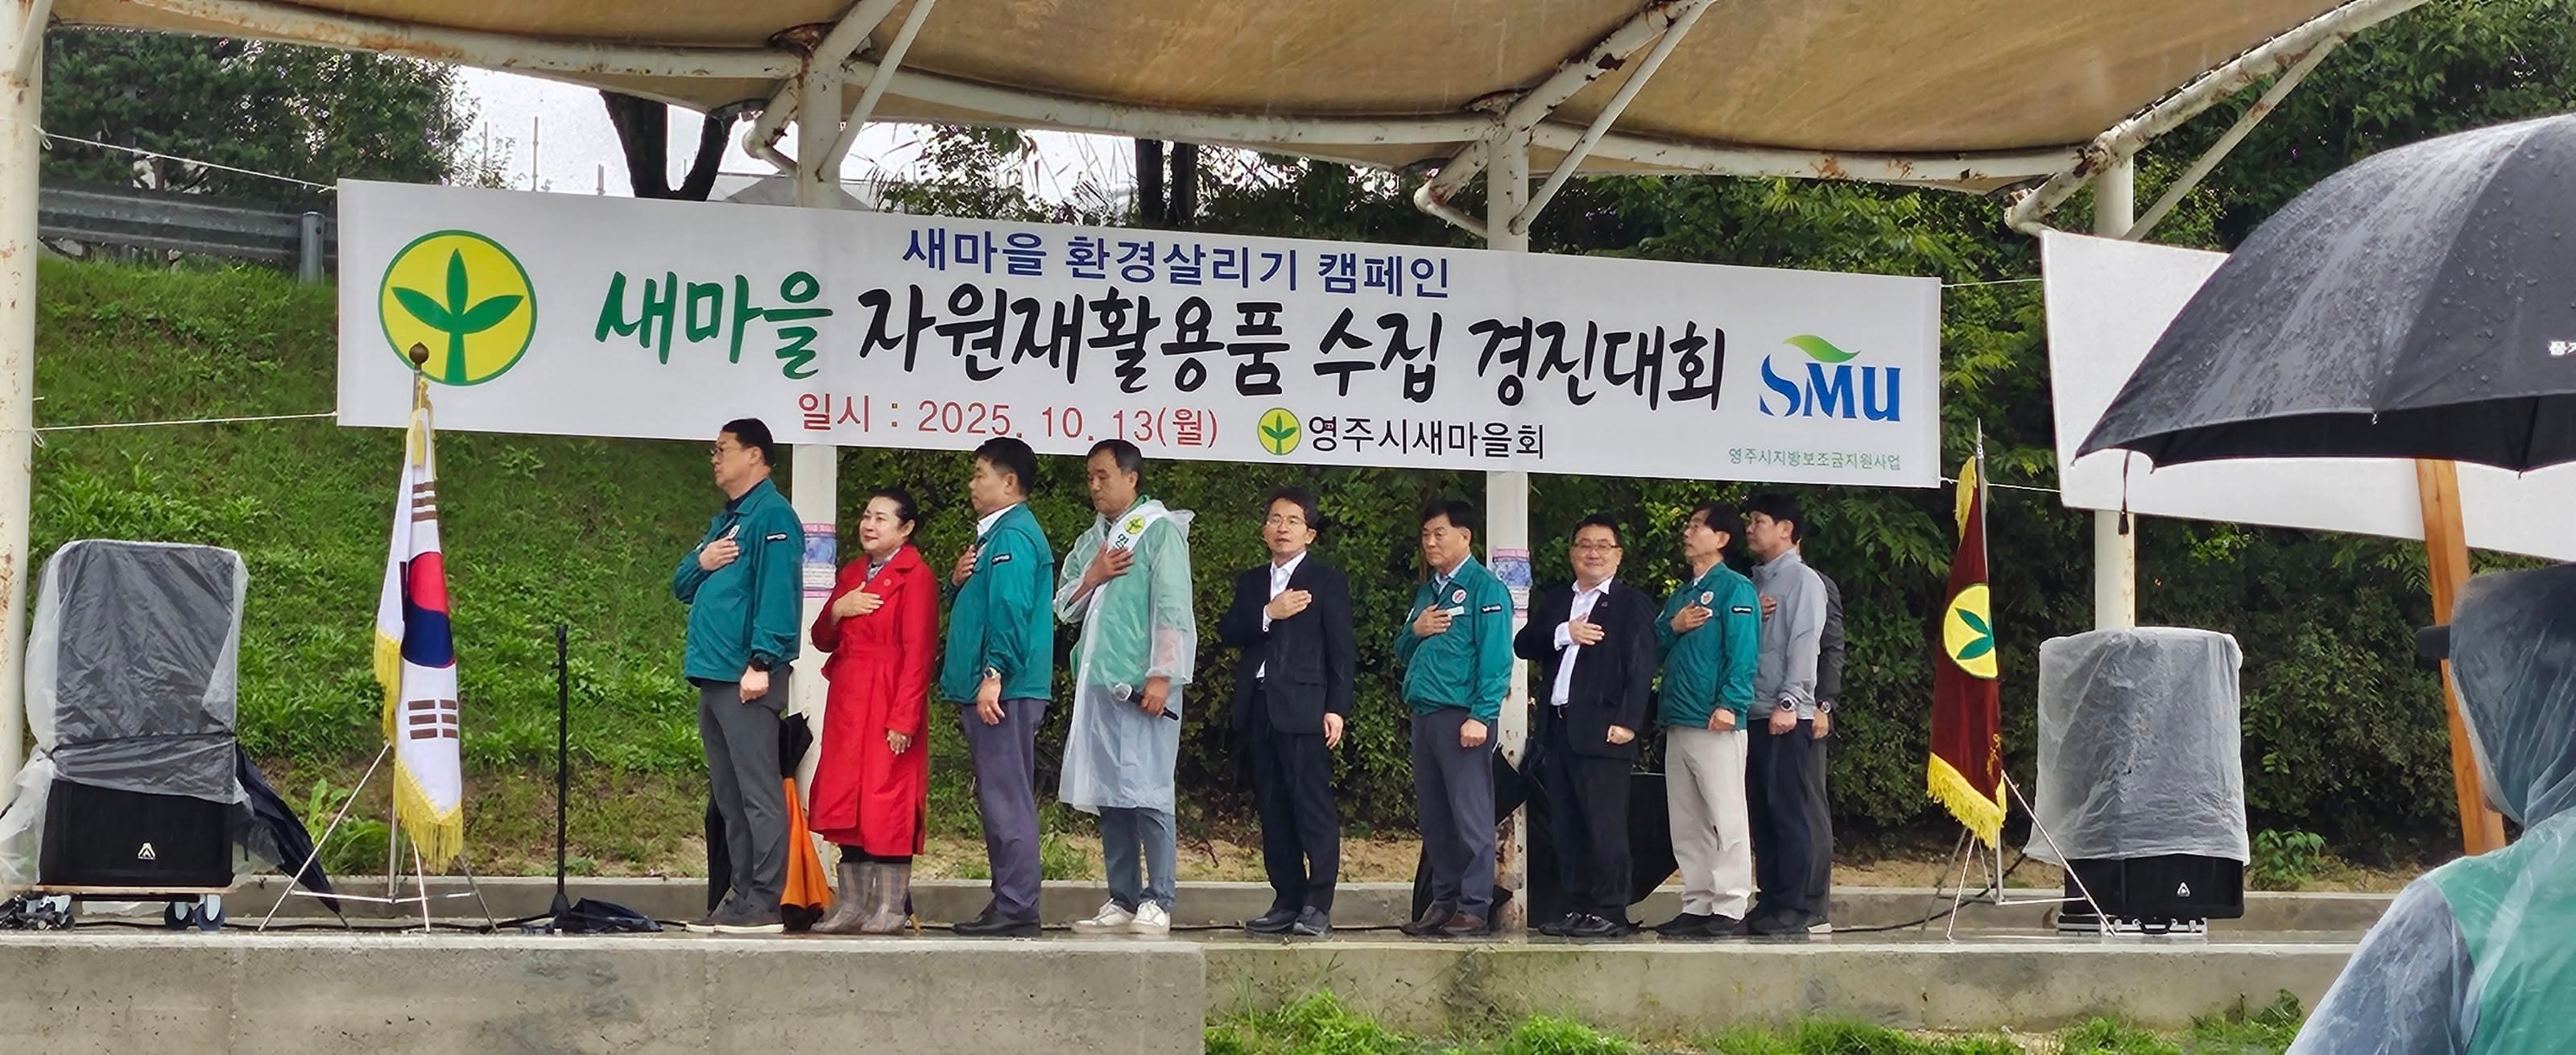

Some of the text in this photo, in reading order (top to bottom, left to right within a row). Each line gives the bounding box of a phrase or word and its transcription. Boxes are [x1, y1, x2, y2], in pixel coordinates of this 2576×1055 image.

[902, 227, 1449, 299] 새마을 환경살리기 캠페인
[594, 270, 1727, 411] 새마을 자원재활용품 수집 경진대회
[797, 392, 870, 432] 일시
[917, 399, 1023, 440] 2025.
[1041, 406, 1095, 442] 10.
[1112, 406, 1218, 449] 13(월)
[1308, 415, 1544, 460] 영주시새마을회
[1728, 447, 1901, 471] 영주시지방보조금지원사업
